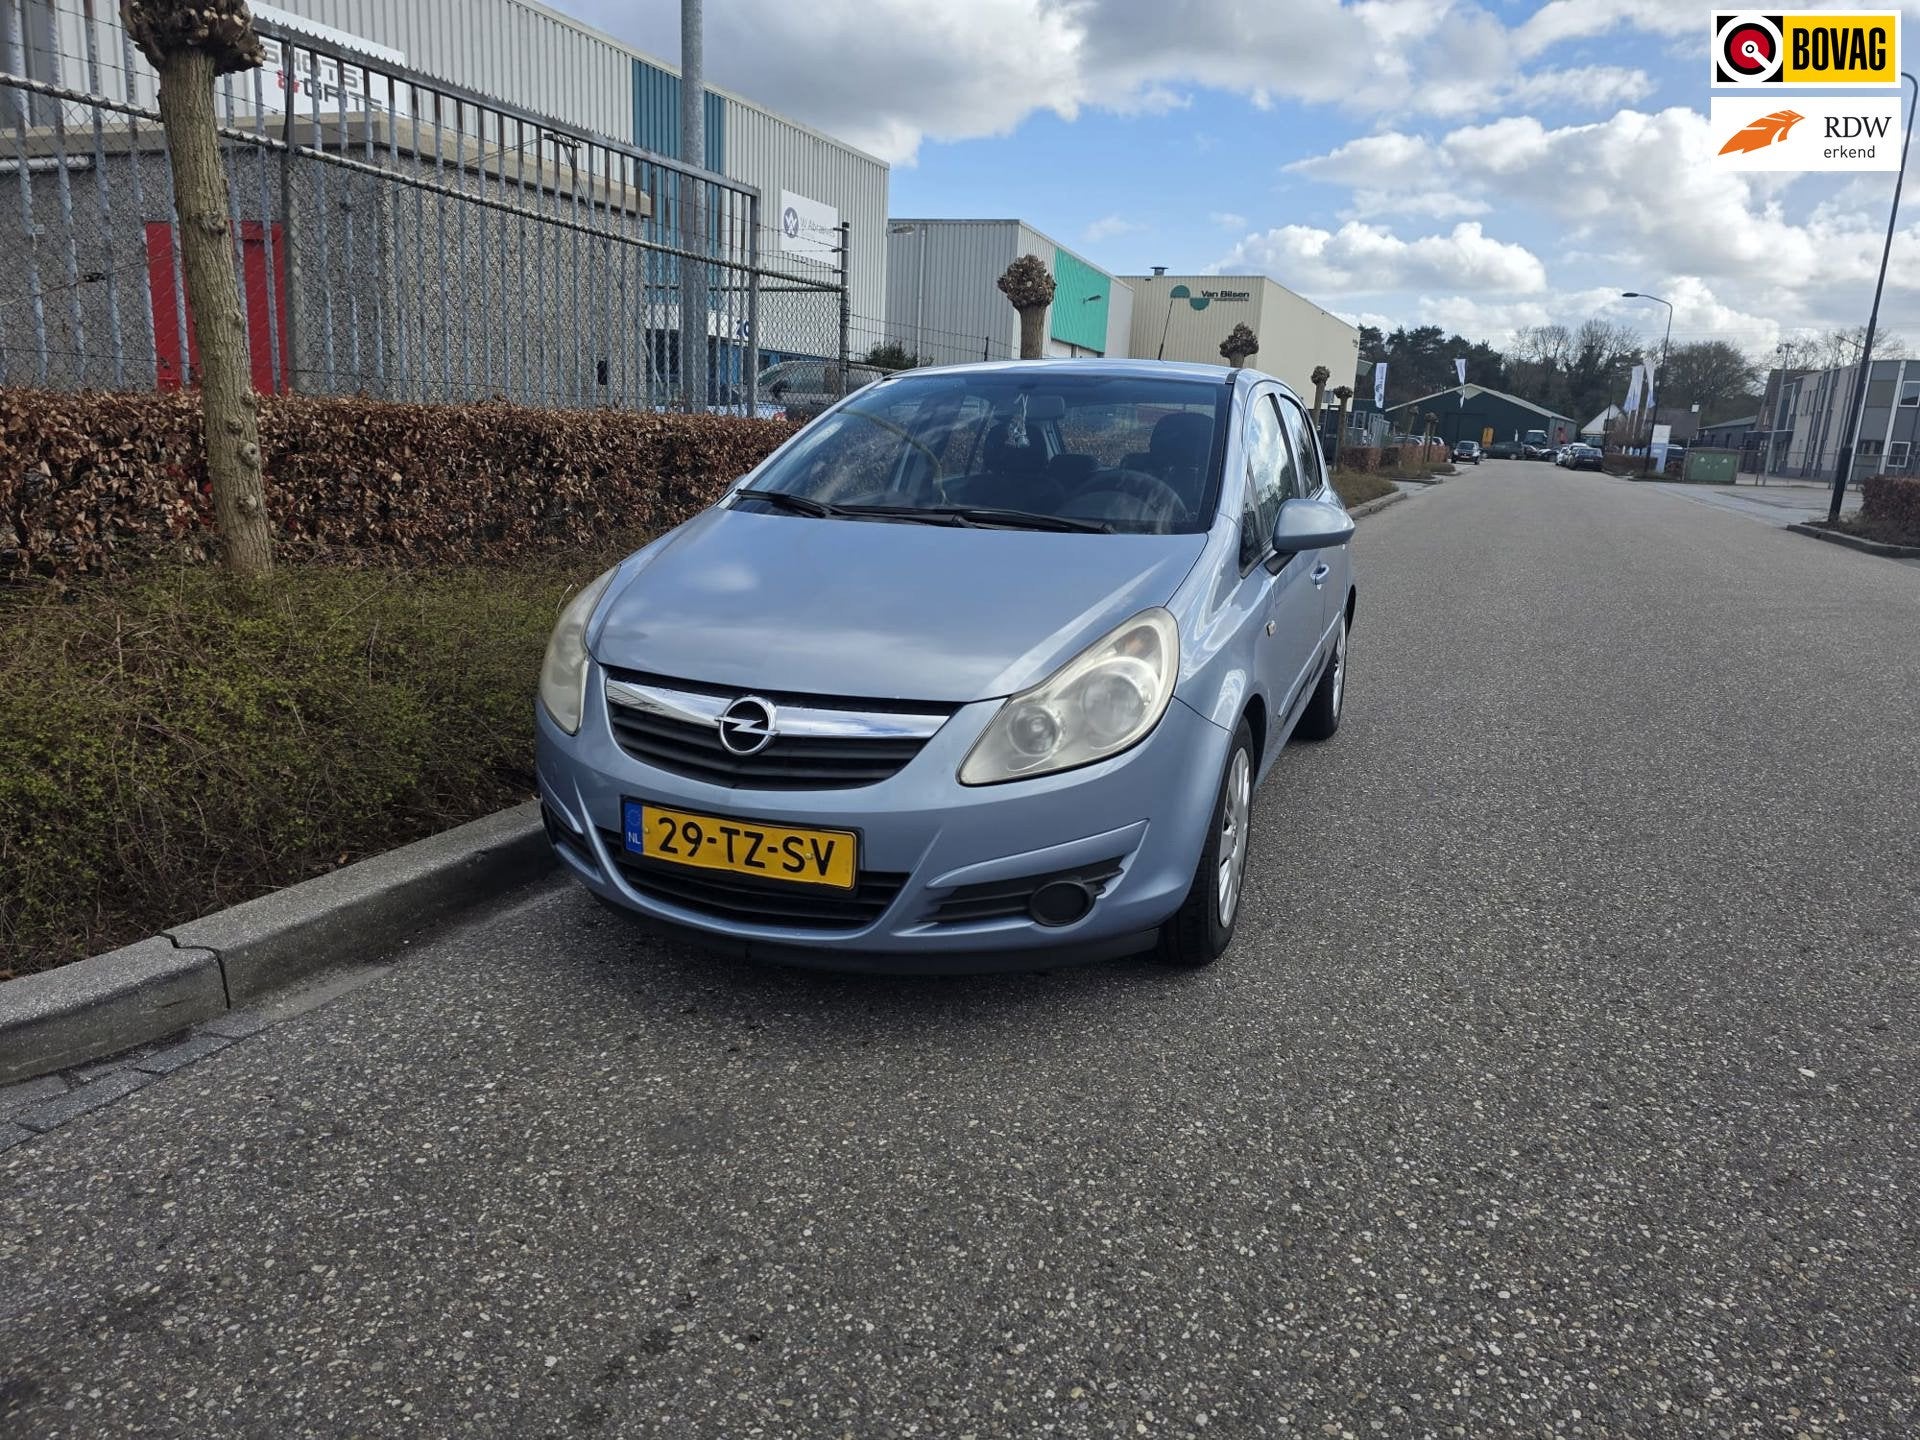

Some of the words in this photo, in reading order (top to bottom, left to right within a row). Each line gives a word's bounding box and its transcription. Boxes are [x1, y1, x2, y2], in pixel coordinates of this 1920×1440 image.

[1201, 290, 1218, 298] Van
[1220, 290, 1250, 298] Bilsen
[628, 831, 641, 845] NL
[658, 817, 836, 876] 29-TZ-SV
